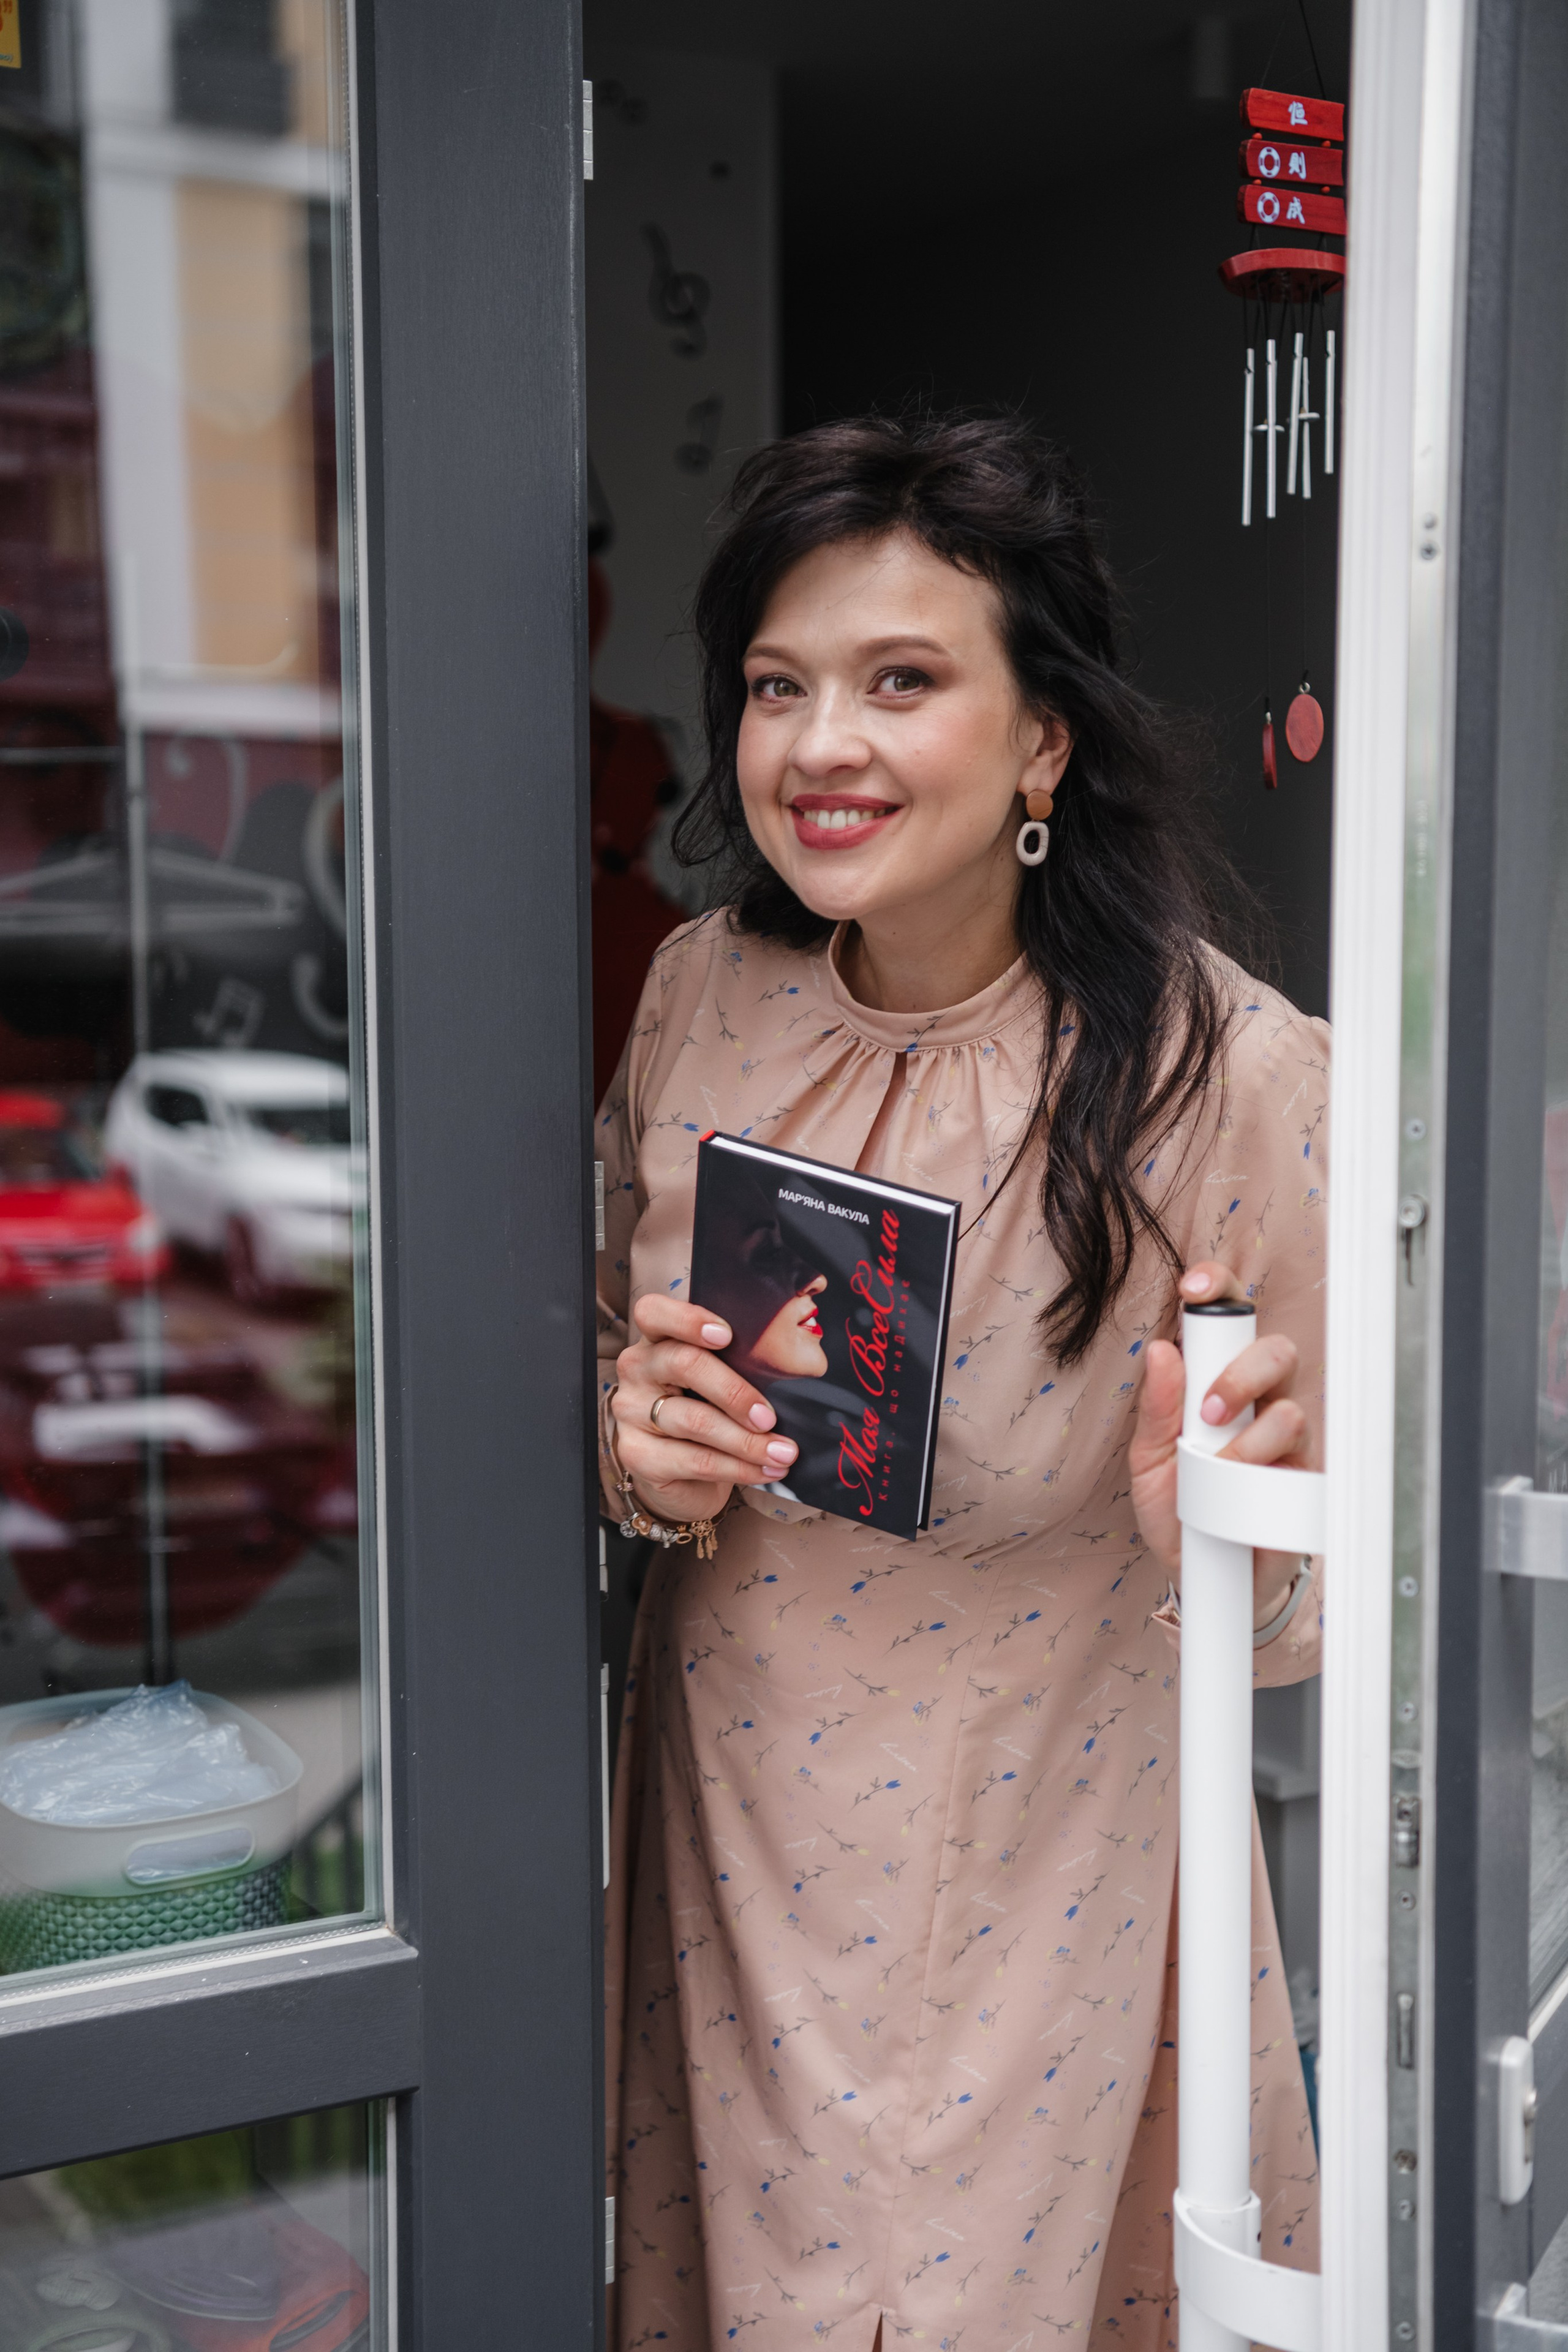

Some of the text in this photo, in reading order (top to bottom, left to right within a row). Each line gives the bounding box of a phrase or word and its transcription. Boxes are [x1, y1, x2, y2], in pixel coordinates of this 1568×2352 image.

[778, 1188, 870, 1225] МАР'ЯНА ВАКУЛА
[845, 1208, 900, 1396] ВсеСила
[889, 1389, 900, 1414] що
[838, 1406, 880, 1517] Моя
